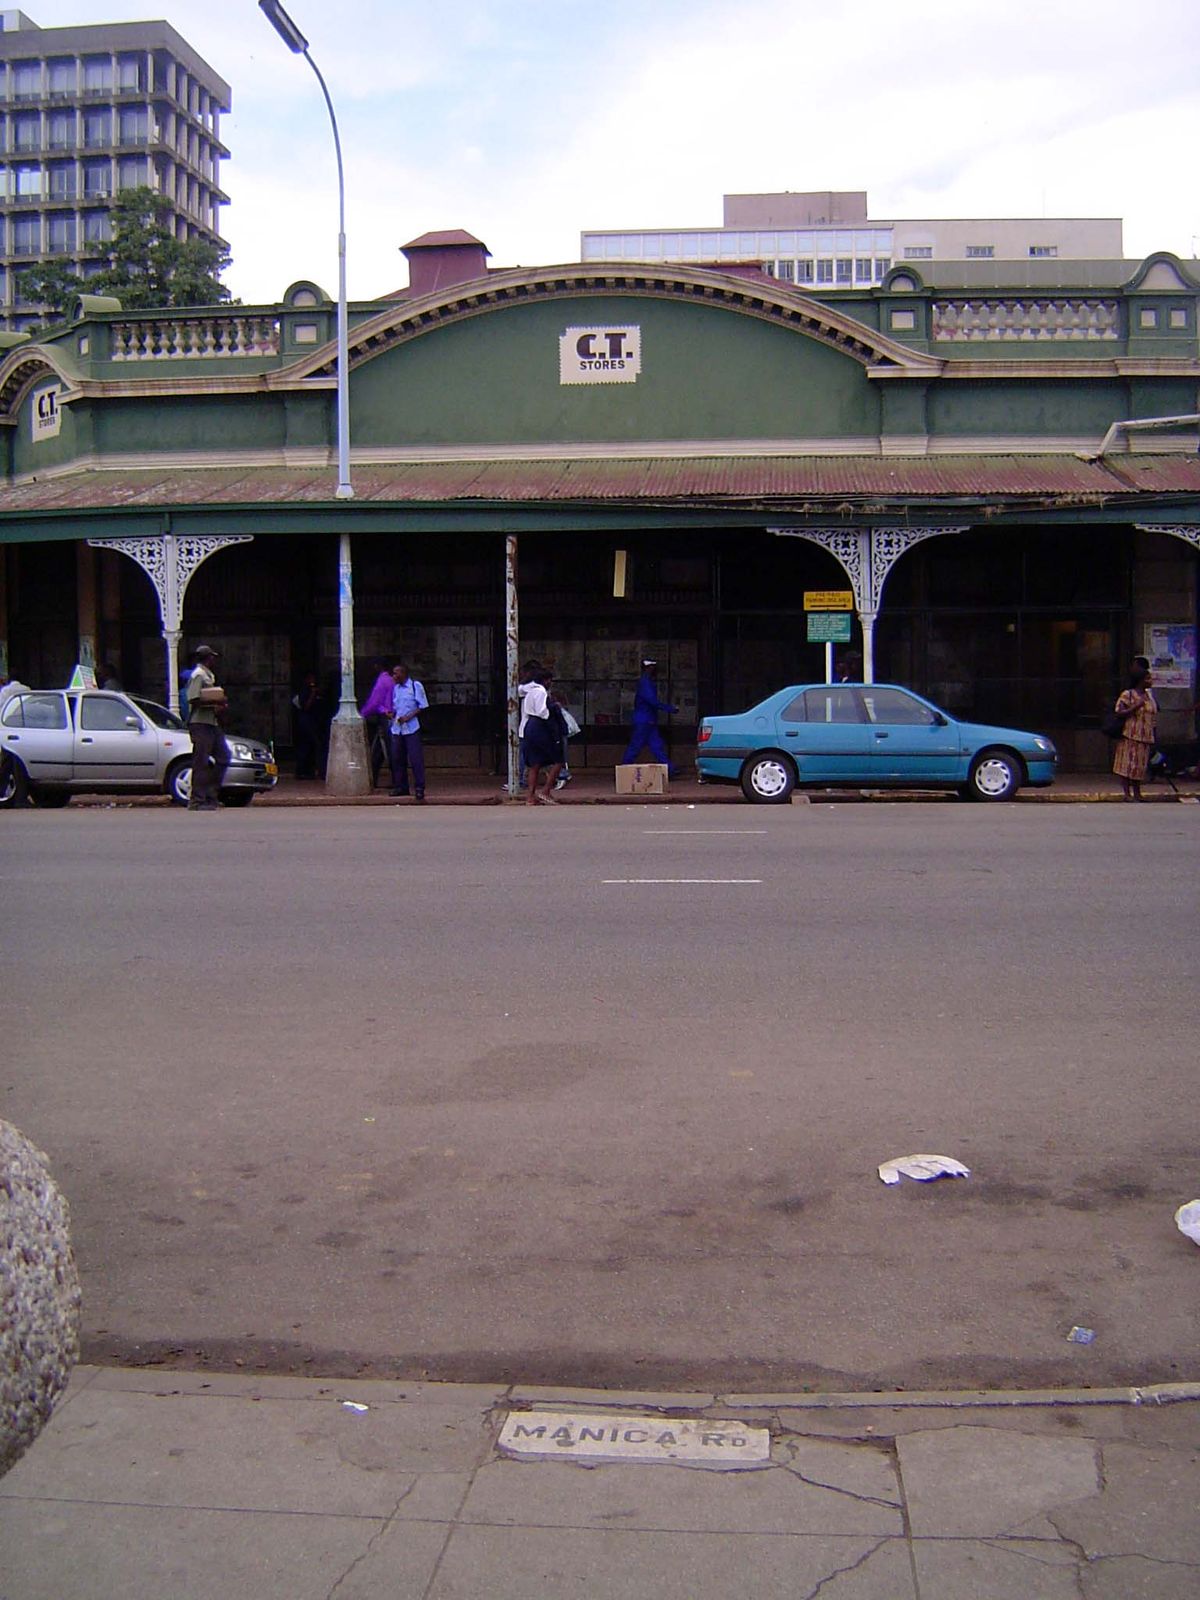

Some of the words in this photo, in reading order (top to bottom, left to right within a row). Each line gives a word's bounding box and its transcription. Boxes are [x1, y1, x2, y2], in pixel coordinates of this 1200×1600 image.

[576, 332, 633, 360] C.T.
[579, 360, 625, 370] STORES
[38, 391, 58, 418] C.T.
[513, 1424, 679, 1445] MANICA
